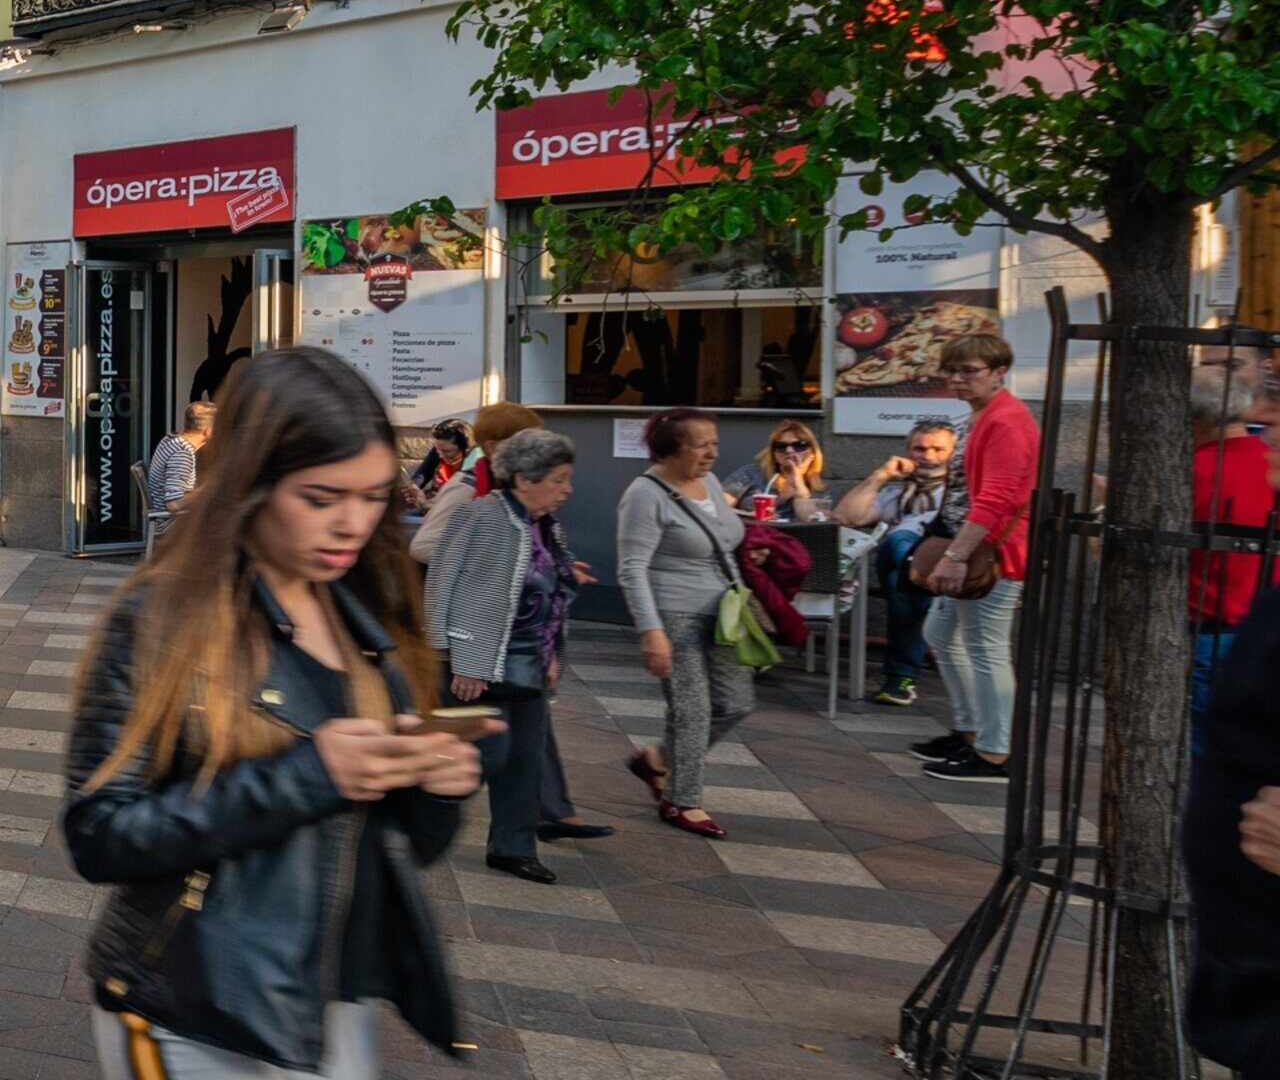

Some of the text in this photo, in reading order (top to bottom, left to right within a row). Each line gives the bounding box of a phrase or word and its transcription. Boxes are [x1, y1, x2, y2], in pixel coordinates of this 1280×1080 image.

[512, 110, 800, 167] ópera:p
[86, 166, 278, 208] ópera:pizza
[370, 265, 408, 276] NUEVAS
[876, 251, 958, 263] 100% Natural
